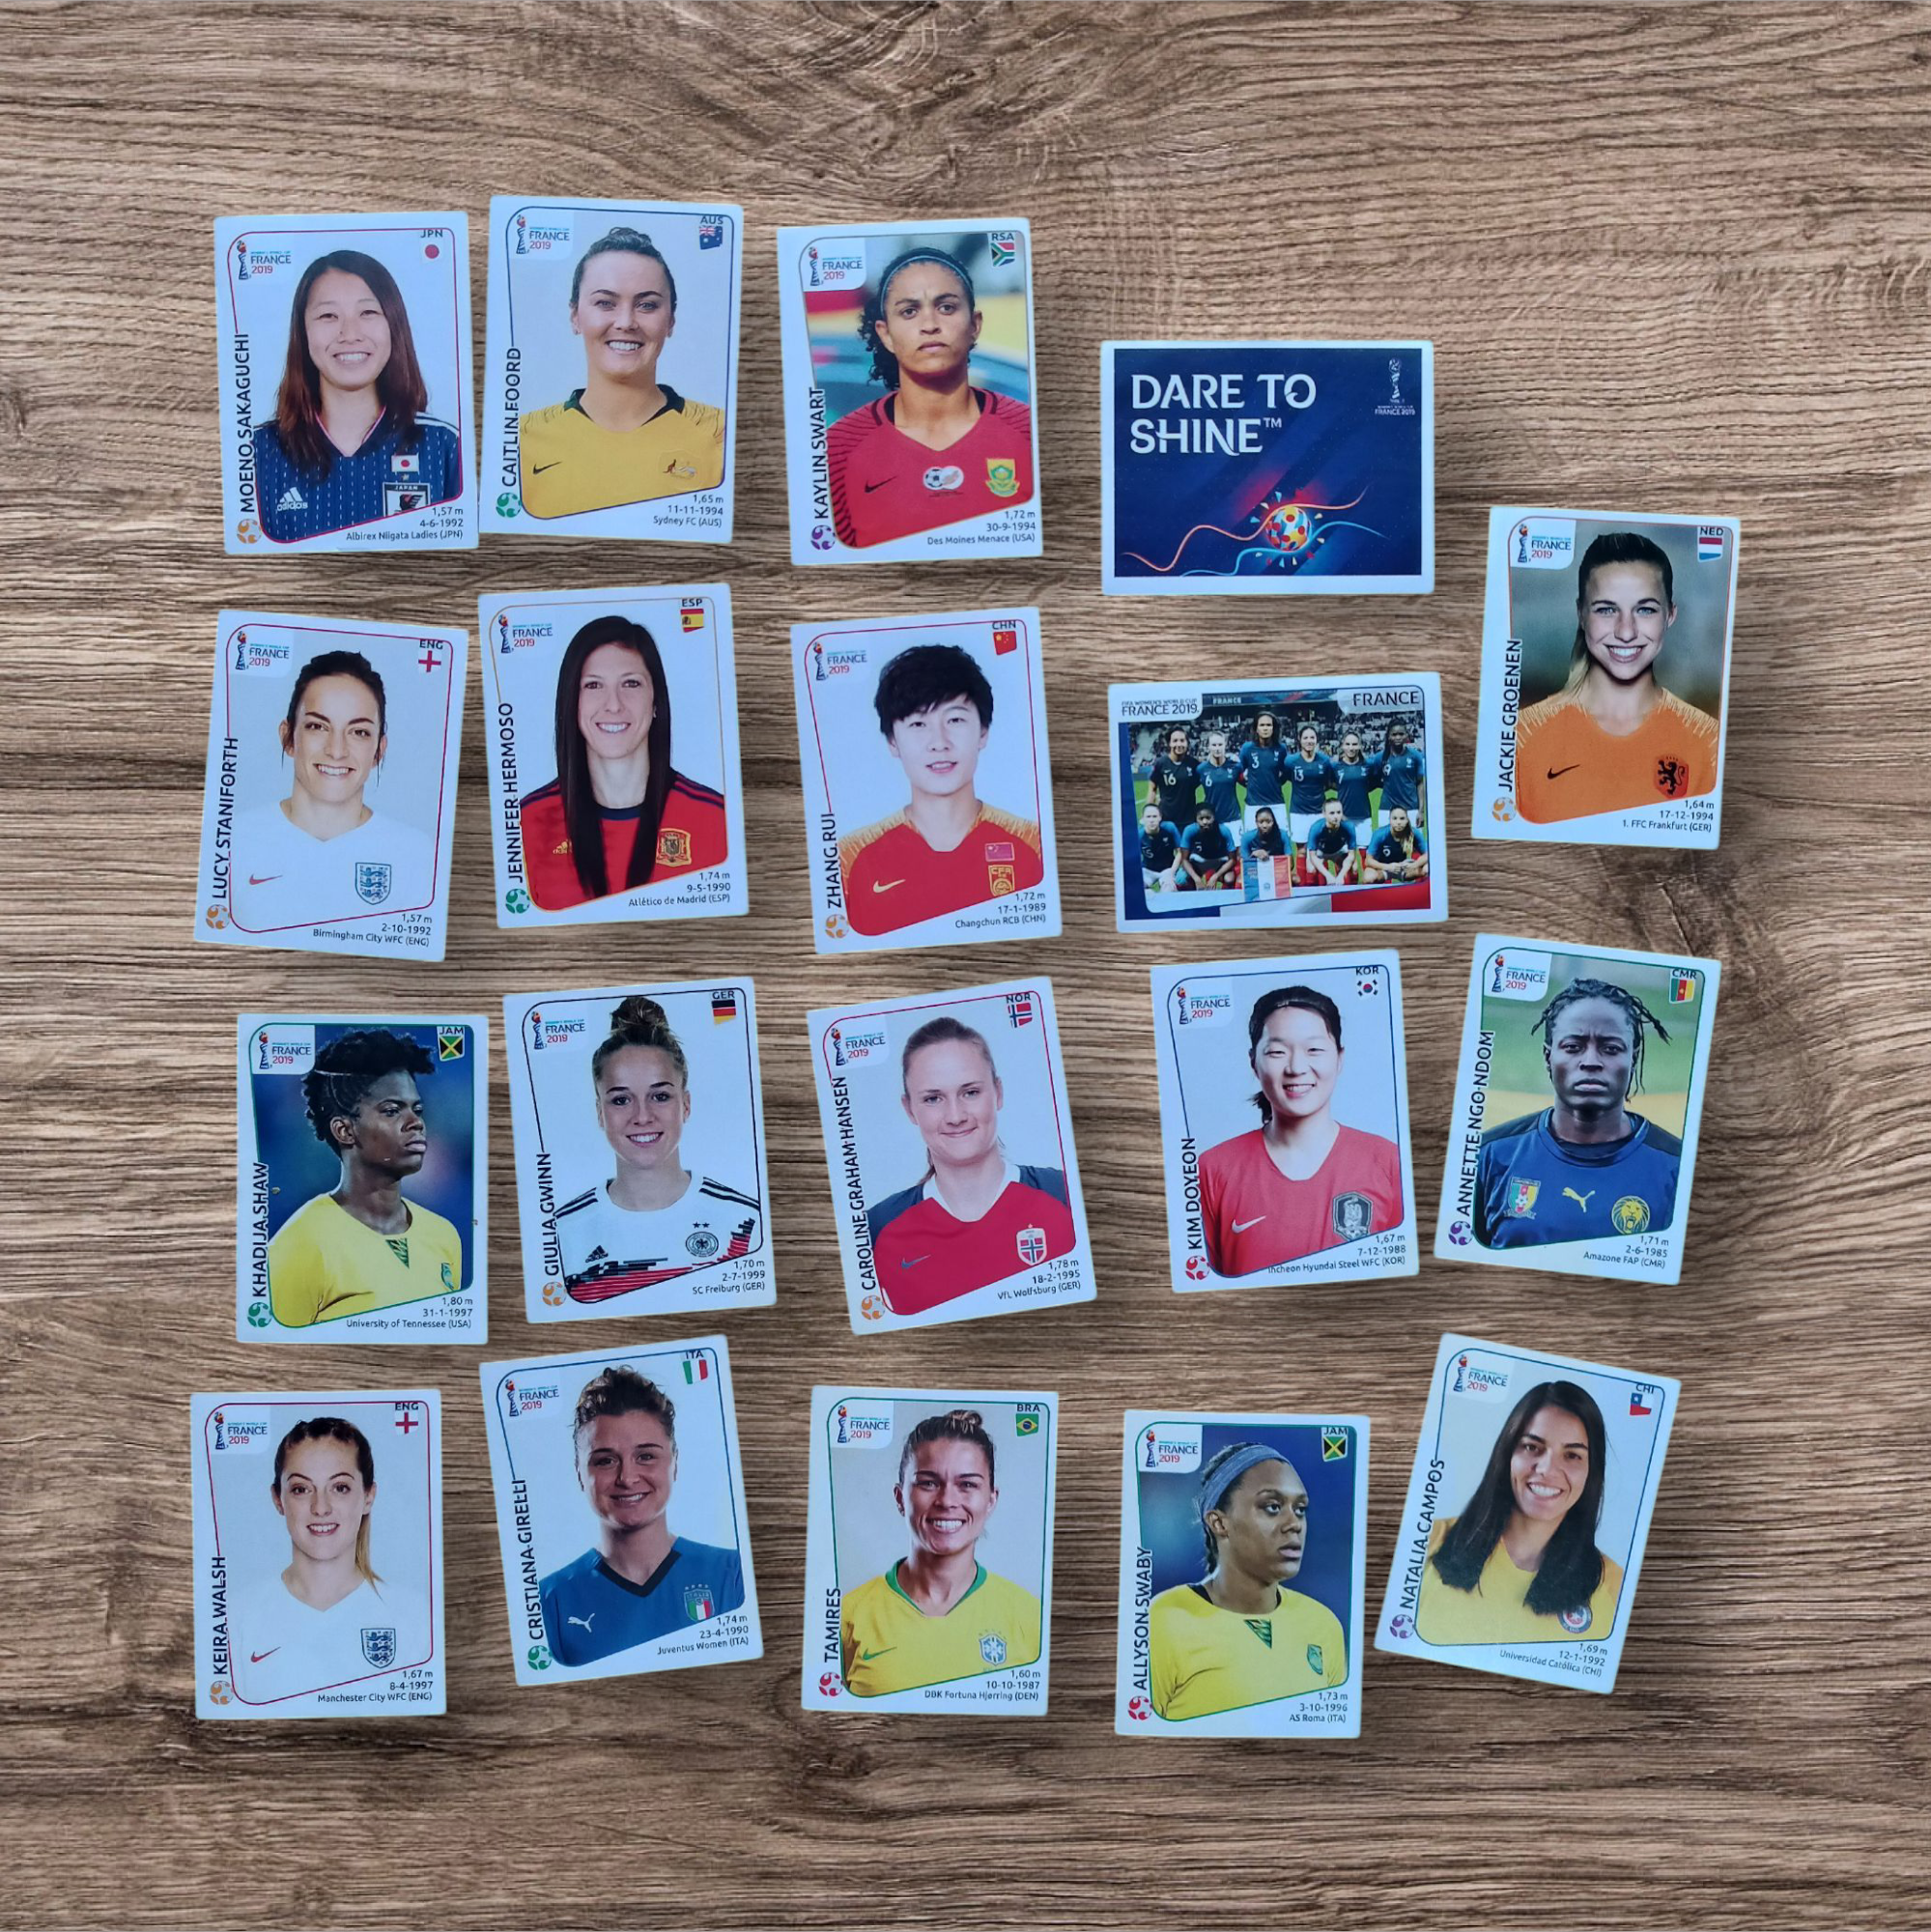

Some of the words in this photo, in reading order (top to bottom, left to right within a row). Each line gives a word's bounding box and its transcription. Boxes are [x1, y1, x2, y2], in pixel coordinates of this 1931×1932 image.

[699, 215, 724, 224] AUS
[421, 229, 442, 238] JPN
[529, 231, 570, 241] FRANCE
[991, 233, 1014, 242] RSA
[251, 255, 292, 265] FRANCE
[823, 261, 863, 270] FRANCE
[251, 266, 272, 274] 2019
[823, 271, 844, 280] 2019
[504, 349, 521, 412] FOORD
[235, 334, 252, 439] SAKAGUCHI
[1132, 374, 1245, 410] DARE
[1257, 374, 1316, 410] TO
[809, 387, 827, 451] SWART
[502, 417, 519, 487] CAITLIN
[239, 444, 255, 512] MOENO
[812, 456, 829, 520] KAYLIN
[694, 495, 713, 504] 1,65
[276, 500, 308, 512] adidas
[667, 505, 724, 514] 11-11-1994
[432, 507, 452, 517] 1,57
[1005, 510, 1025, 520] 1,72
[420, 519, 464, 527] 4-6-1992
[653, 516, 684, 526] Sydney
[698, 517, 723, 527] (AUS)
[986, 522, 1036, 531] 30-9-1994
[1700, 527, 1723, 536] NED
[1012, 533, 1035, 543] (USA)
[1531, 541, 1571, 551] FRANCE
[1532, 550, 1552, 558] 2019
[991, 620, 1016, 630] CHN
[513, 628, 553, 638] FRANCE
[419, 639, 443, 649] ENG
[514, 639, 535, 647] 2019
[249, 648, 290, 659] FRANCE
[249, 658, 270, 667] 2019
[827, 654, 867, 665] FRANCE
[829, 665, 850, 674] 2019
[1502, 640, 1522, 726] GROENEN
[1353, 691, 1419, 706] FRANCE
[1122, 705, 1169, 717] FRANCE
[498, 703, 518, 792] HERMOSO
[1498, 731, 1517, 792] JACKIE
[1163, 773, 1177, 785] 16
[216, 738, 239, 849] STANIFORTH
[1685, 800, 1704, 810] 1,64
[1660, 810, 1714, 821] 17-12-1994
[821, 813, 837, 841] RUI
[504, 798, 524, 883] JENNIFER
[213, 852, 229, 898] LUCY
[699, 871, 720, 881] 1,74
[823, 846, 842, 908] ZHANG
[687, 883, 730, 893] 9-5-1990
[1014, 893, 1035, 902] 1,72
[998, 903, 1046, 914] 17-1-1989
[402, 914, 421, 923] 1,57
[954, 918, 1001, 927] Changchun
[1022, 914, 1045, 923] (CHN)
[382, 923, 431, 935] 2-10-1992
[313, 929, 363, 941] Birmingham
[365, 933, 383, 943] City
[384, 935, 403, 944] WFC
[406, 937, 429, 947] (ENG)
[1356, 966, 1379, 976] KOR
[1672, 969, 1696, 980] CMR
[1506, 971, 1546, 983] FRANCE
[712, 991, 734, 1000] GER
[1007, 993, 1032, 1004] NOR
[1190, 999, 1231, 1009] FRANCE
[1192, 1009, 1213, 1018] 2019
[440, 1026, 464, 1036] JAM
[545, 1023, 585, 1034] FRANCE
[547, 1034, 568, 1043] 2019
[846, 1037, 886, 1049] FRANCE
[272, 1047, 311, 1056] FRANCE
[272, 1056, 294, 1065] 2019
[1473, 1030, 1495, 1087] NDOM
[833, 1076, 855, 1140] HANSEN
[1468, 1092, 1486, 1130] NGO
[843, 1143, 866, 1211] GRAHAM
[1180, 1138, 1200, 1211] DOYEON
[1457, 1133, 1480, 1217] ANNETTE
[537, 1153, 554, 1213] GWINN
[253, 1163, 269, 1215] SHAW
[1186, 1217, 1203, 1250] KIM
[1376, 1235, 1395, 1244] 1,67
[1640, 1235, 1660, 1246] 1,71
[542, 1218, 559, 1275] GIULIA
[1357, 1246, 1406, 1256] 7-12-1988
[1625, 1245, 1667, 1258] 2-6-1985
[252, 1220, 267, 1296] KHADIJA
[853, 1214, 877, 1291] CAROLINE
[734, 1260, 753, 1269] 1,70
[1048, 1260, 1069, 1271] 1,78
[723, 1271, 765, 1281] 2-7-1999
[1033, 1271, 1080, 1285] 18-2-1995
[705, 1284, 740, 1294] Freiburg
[742, 1281, 765, 1293] (GER)
[442, 1296, 463, 1306] 1,80
[423, 1308, 473, 1318] 31-1-1997
[346, 1320, 388, 1329] University
[448, 1318, 471, 1328] (USA)
[686, 1350, 703, 1359] ITA
[1468, 1372, 1508, 1387] FRANCE
[1635, 1383, 1655, 1395] CHI
[520, 1389, 560, 1401] FRANCE
[395, 1403, 419, 1411] ENG
[522, 1401, 543, 1410] 2019
[1016, 1404, 1040, 1412] BRA
[228, 1427, 268, 1435] FRANCE
[850, 1421, 890, 1430] FRANCE
[1323, 1426, 1347, 1435] JAM
[229, 1435, 249, 1444] 2019
[851, 1430, 871, 1438] 2019
[1159, 1445, 1198, 1455] FRANCE
[512, 1480, 533, 1543] GIRELLI
[1400, 1538, 1428, 1609] NATALIA
[1417, 1458, 1445, 1534] CAMPOS
[1136, 1548, 1151, 1607] SWABY
[213, 1557, 227, 1619] WALSH
[521, 1548, 544, 1640] CRISTIANA
[718, 1615, 737, 1625] 1,74
[825, 1588, 840, 1663] TAMIRES
[699, 1626, 749, 1638] 23-4-1990
[213, 1623, 228, 1675] KEIRA
[1134, 1613, 1150, 1690] ALLYSON
[1578, 1642, 1598, 1654] 1,69
[1559, 1650, 1605, 1667] 12-1-1992
[403, 1670, 423, 1680] 1,67
[1010, 1670, 1031, 1679] 1,60
[390, 1681, 433, 1690] 8-4-1997
[987, 1681, 1039, 1690] 10-10-1987
[369, 1692, 385, 1703] City
[387, 1692, 406, 1701] WFC
[410, 1690, 433, 1702] (ENG)
[1319, 1691, 1338, 1701] 1,73
[1300, 1702, 1349, 1712] 3-10-1996
[1327, 1714, 1347, 1723] (ITA)
